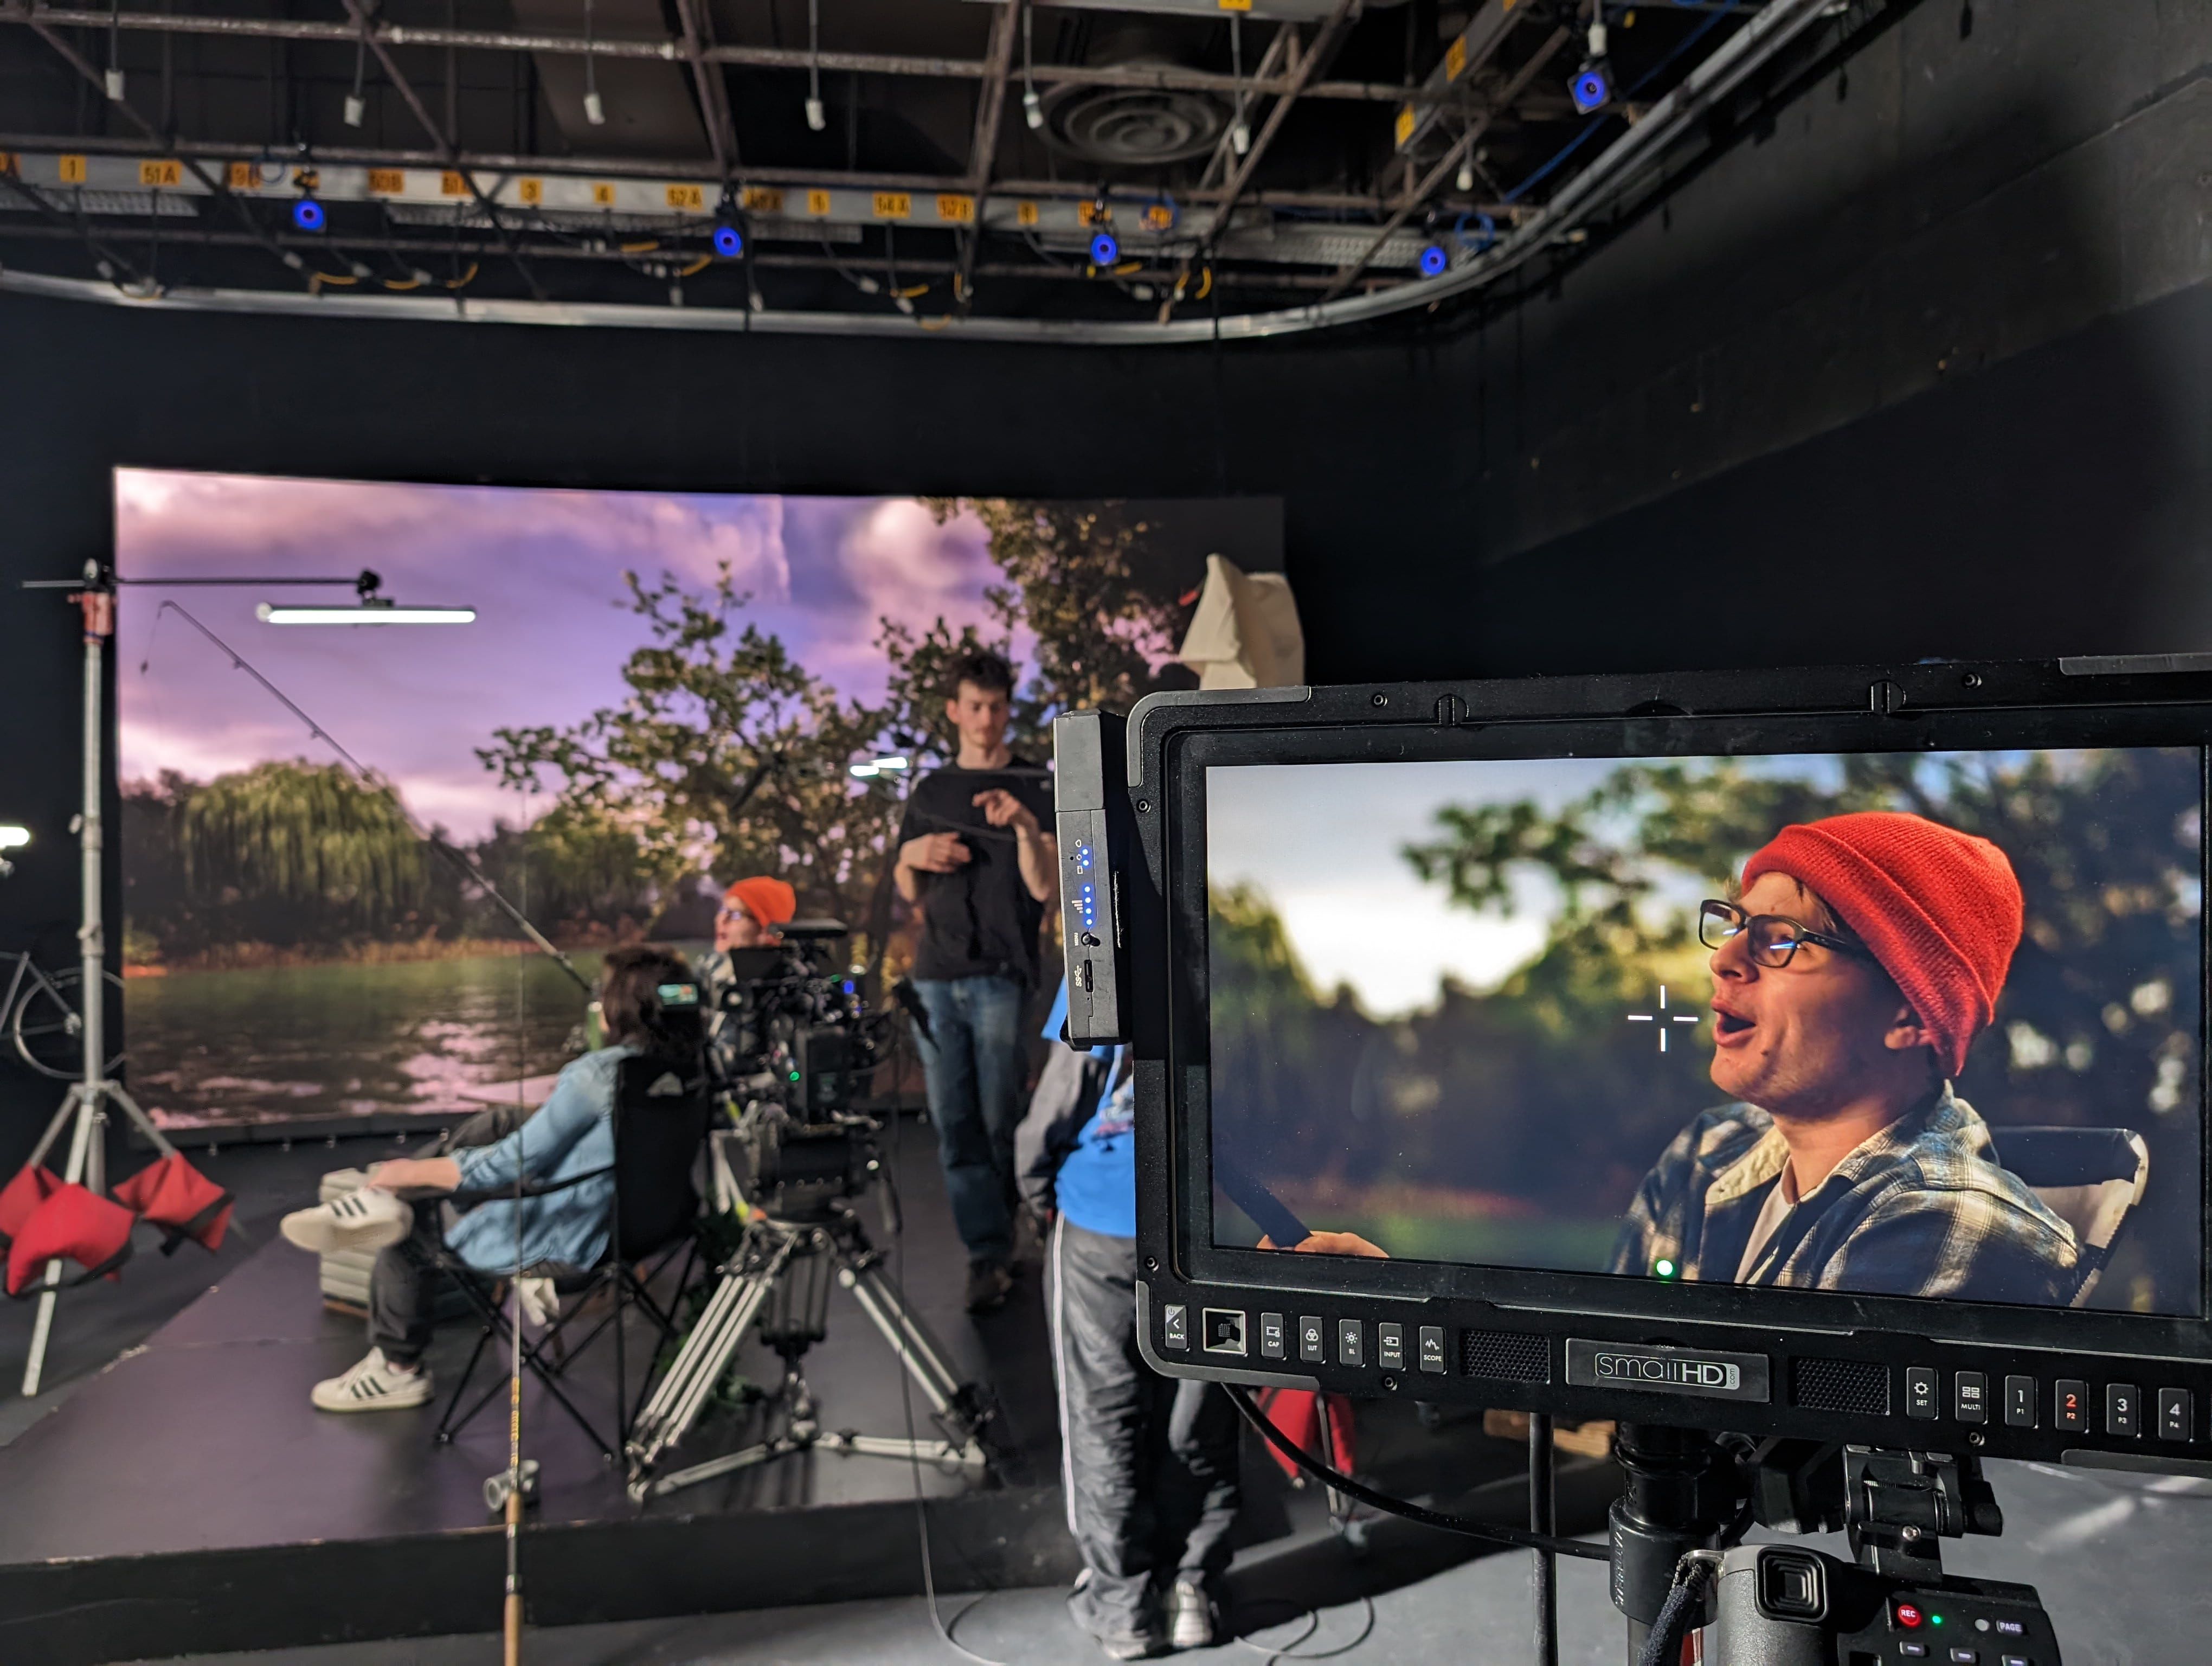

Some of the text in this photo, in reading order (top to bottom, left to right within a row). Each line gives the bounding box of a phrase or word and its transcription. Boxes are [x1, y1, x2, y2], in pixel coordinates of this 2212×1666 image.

[1599, 1356, 1724, 1385] smallHD
[2018, 1390, 2023, 1402] 1
[2066, 1394, 2076, 1407] 2
[2117, 1398, 2127, 1412] 3
[2169, 1403, 2181, 1415] 4
[1901, 1609, 1915, 1618] REC
[1999, 1621, 2022, 1632] PAGE
